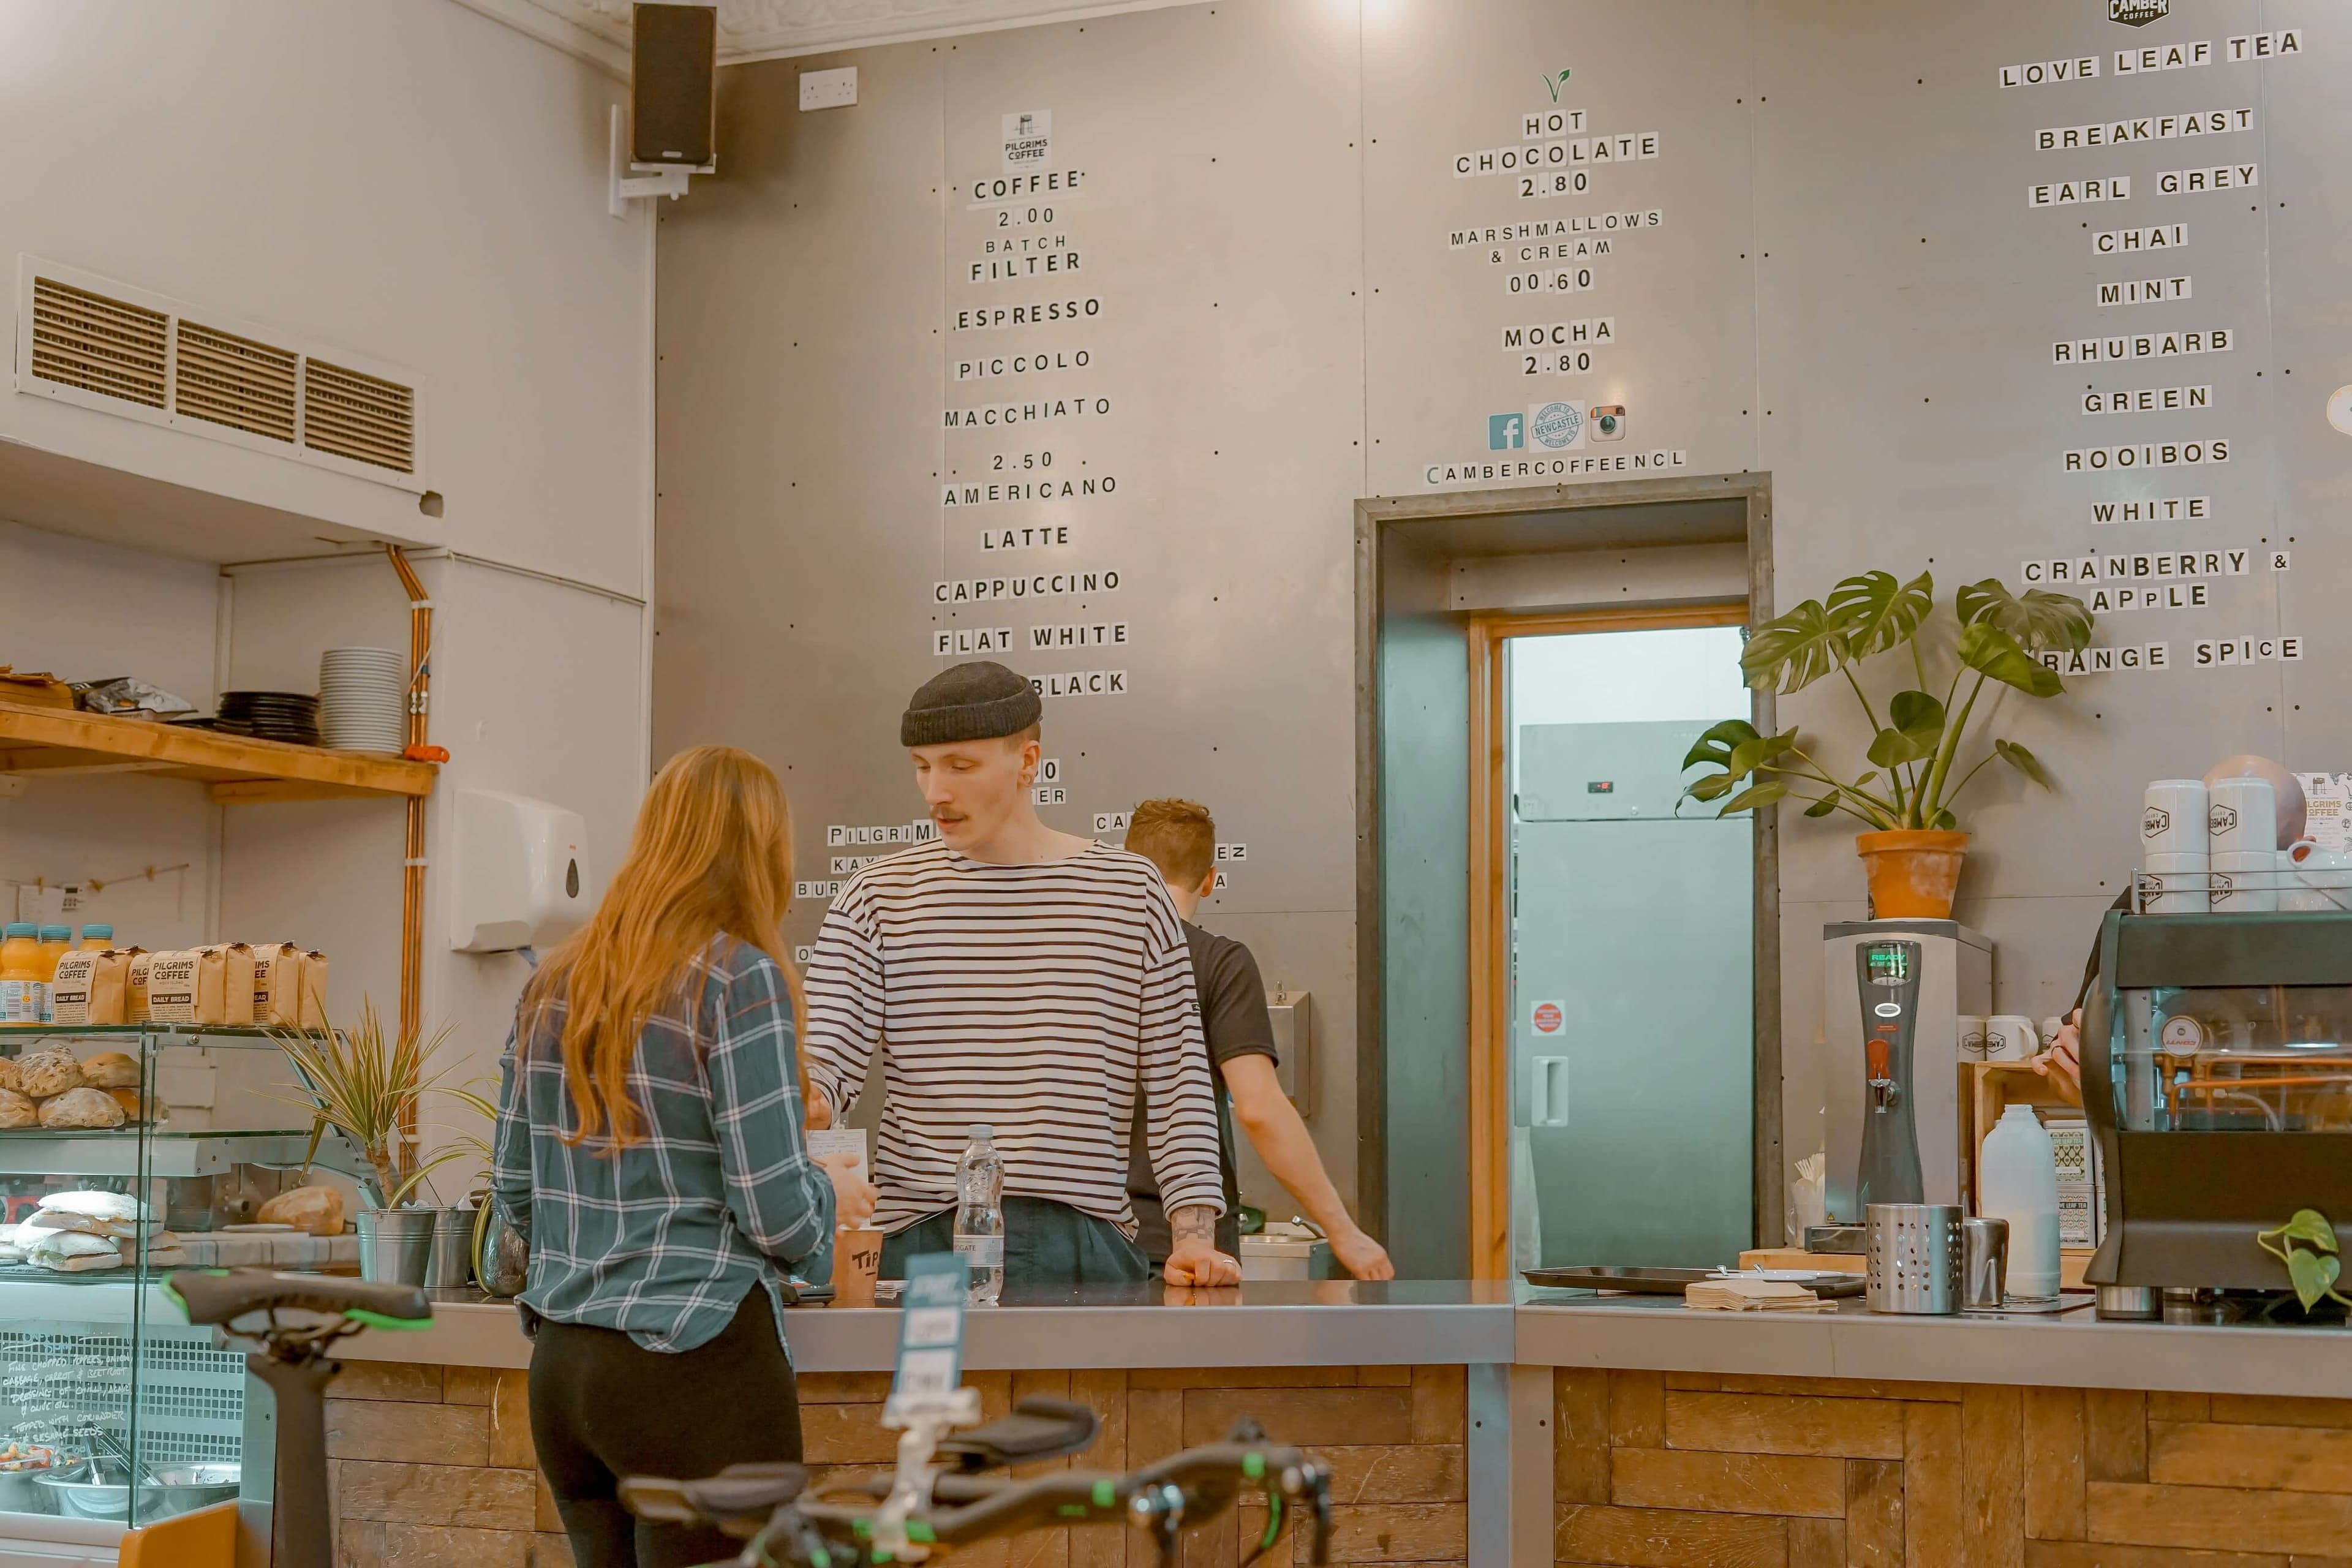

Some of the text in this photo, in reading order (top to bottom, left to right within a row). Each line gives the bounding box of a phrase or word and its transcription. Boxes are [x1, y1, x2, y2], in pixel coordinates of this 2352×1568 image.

[2109, 0, 2168, 19] CAMBER
[2124, 10, 2155, 20] COFFEE
[2003, 33, 2298, 86] LOVE LEAF TEA
[1527, 112, 1582, 135] HOT
[2040, 109, 2251, 149] BREAKFAST
[1005, 138, 1048, 151] PILGRIMS
[1008, 148, 1045, 160] COFFEE
[1457, 138, 1655, 175] CHOCOLATE
[974, 170, 1077, 199] COFFEE
[1522, 173, 1586, 197] 2.80
[2035, 167, 2253, 204] EARL GREY
[999, 208, 1053, 227] 2.00
[1452, 213, 1659, 246] MARSHMALLOWS
[2098, 227, 2180, 252] CHAI
[986, 235, 1065, 253] BATCH
[1491, 241, 1610, 263] & CREAM
[972, 251, 1079, 281] FILTER
[1510, 269, 1590, 292] 00.60
[2101, 279, 2185, 303] MINT
[959, 299, 1099, 329] ESPRESSO
[1505, 322, 1610, 347] MOCHA
[2056, 331, 2227, 361] RHUBARB
[960, 350, 1089, 379] PICCOLO
[1525, 352, 1589, 375] 2.80
[2085, 387, 2205, 412] GREEN
[945, 398, 1109, 426] MACCHIATO
[1539, 405, 1562, 421] WELCOME
[1534, 415, 1580, 436] NEWCASTLE
[993, 451, 1051, 470] 2.50
[1427, 451, 1683, 484] CAMBERCOFFEENCL
[2066, 442, 2227, 470] ROOIBOS
[944, 477, 1115, 505] AMERICANO
[2093, 499, 2204, 522] WHITE
[984, 527, 1068, 549] LATTE
[2026, 552, 2286, 581] CRANBERRY &
[936, 571, 1118, 601] CAPPUCCINO
[2092, 586, 2206, 611] APPLE
[940, 625, 1125, 652] FLAT WHITE
[2044, 639, 2297, 672] RANGE SPICE
[1031, 673, 1124, 696] BLACK
[831, 824, 930, 844] PILGRIM
[59, 960, 91, 970] PILGRIMS
[59, 970, 88, 979] COFFEE
[153, 960, 194, 971] PILGRIMS
[154, 970, 190, 980] COFFEE
[32, 1358, 67, 1371] CHOPPED
[59, 1386, 70, 1396] OF
[30, 1401, 51, 1412] OLIVE
[49, 1414, 69, 1426] WITH
[74, 1426, 104, 1438] SEEDS
